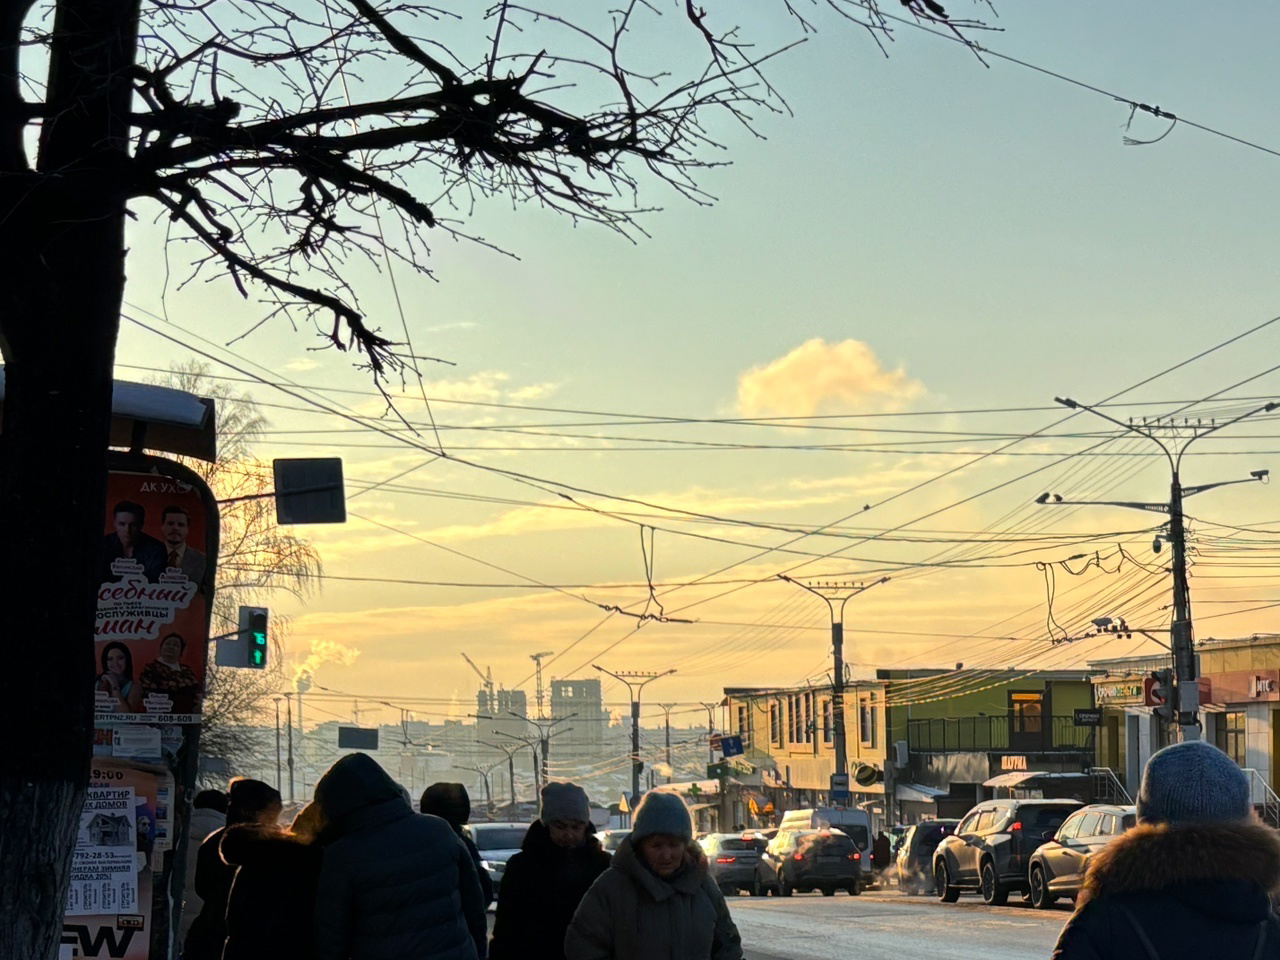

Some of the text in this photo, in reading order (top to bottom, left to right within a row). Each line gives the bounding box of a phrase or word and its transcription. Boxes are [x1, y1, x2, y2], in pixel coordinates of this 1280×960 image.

[140, 482, 158, 492] ДК
[90, 769, 124, 780] 9:00
[95, 800, 128, 809] ДОМОВ
